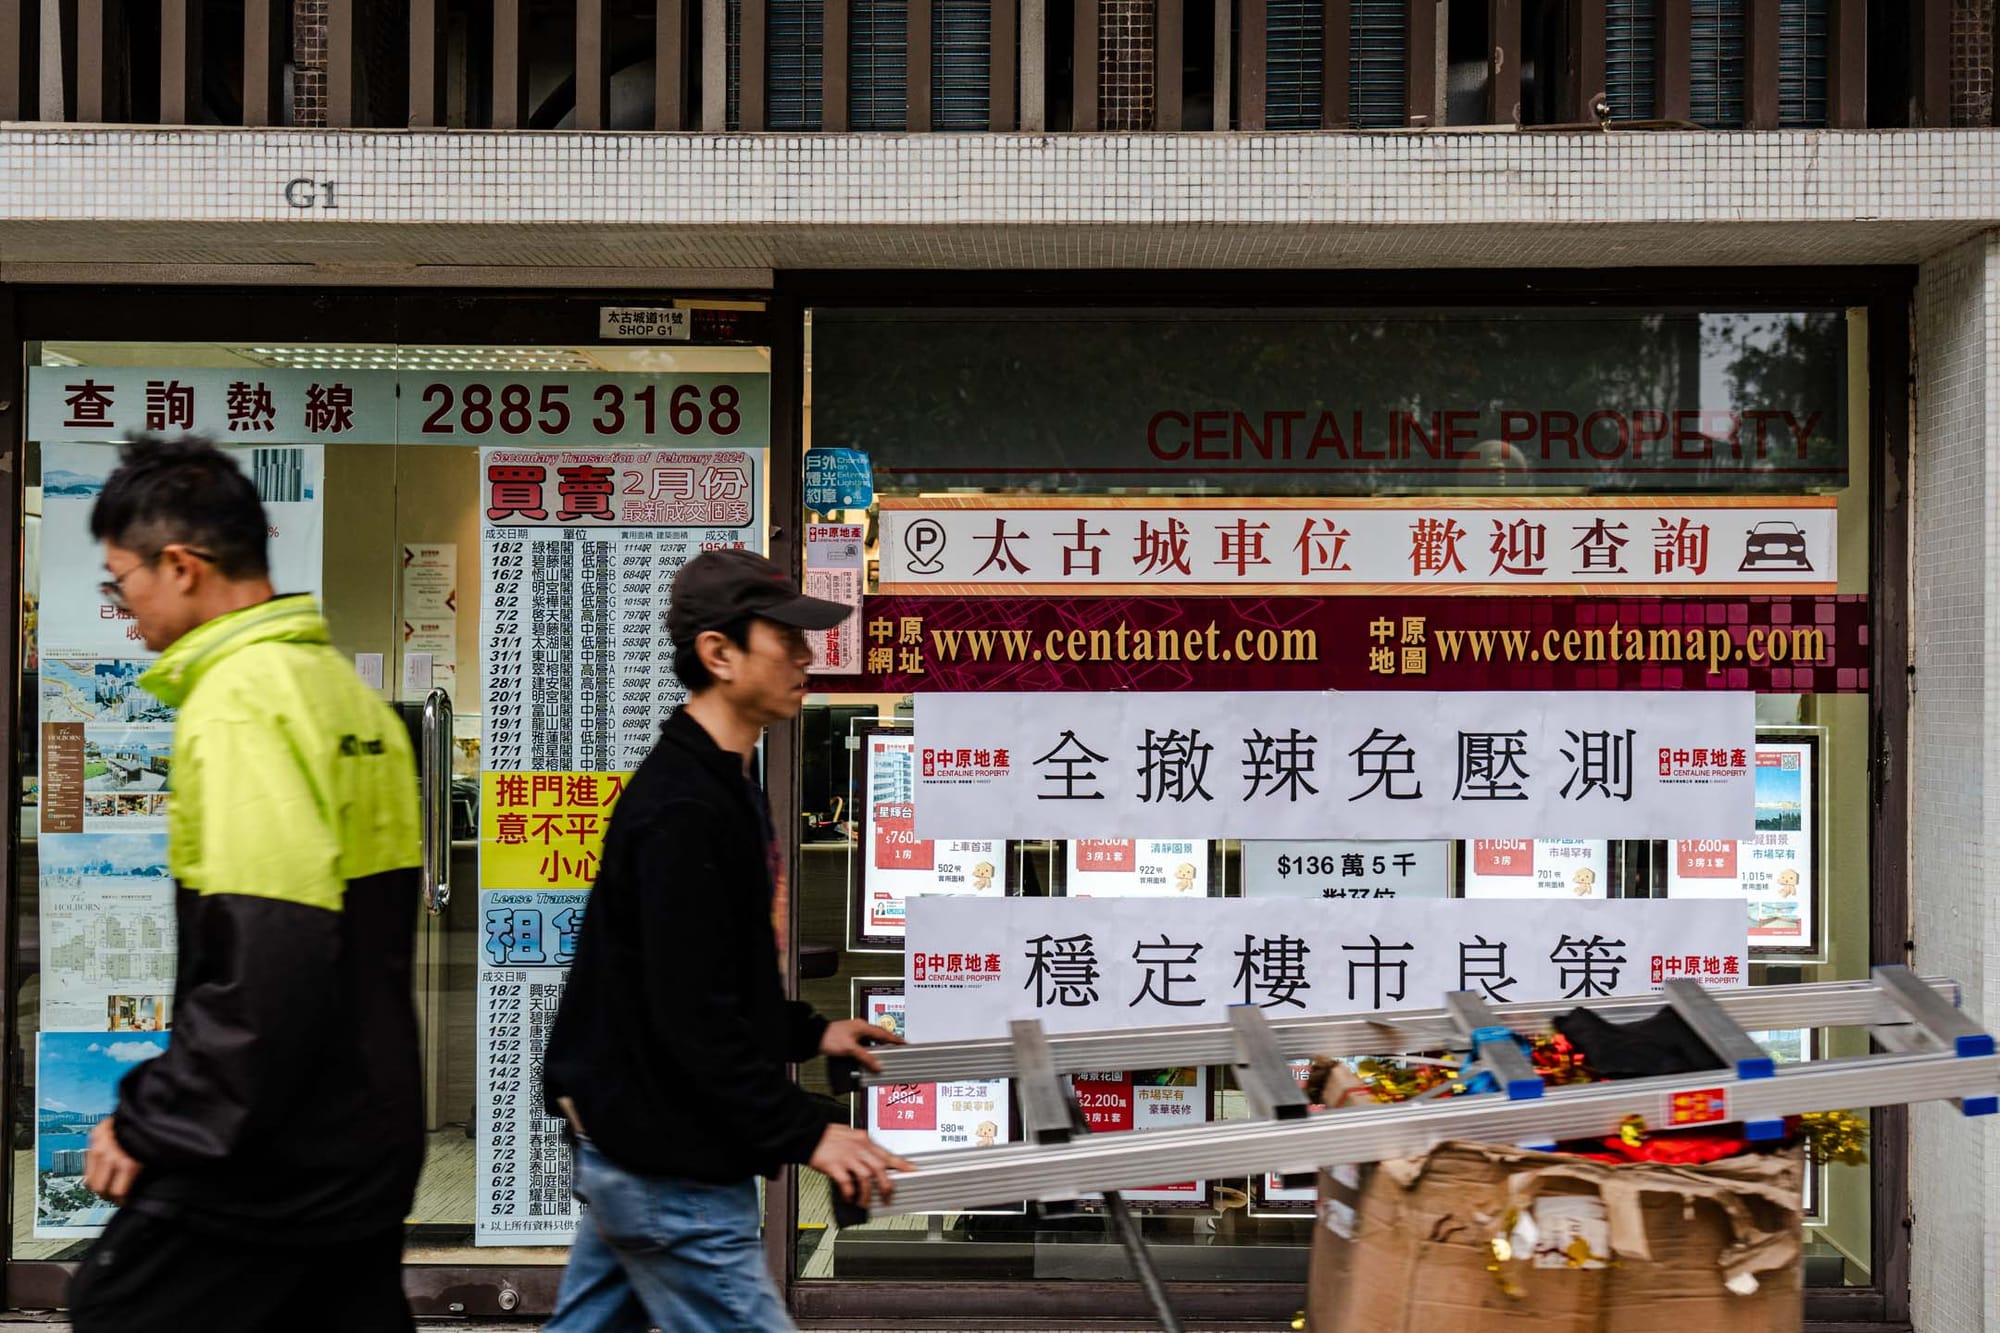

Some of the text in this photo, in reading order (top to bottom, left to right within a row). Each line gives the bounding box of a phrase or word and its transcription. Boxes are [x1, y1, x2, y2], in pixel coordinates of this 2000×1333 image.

[285, 177, 339, 210] G1
[607, 312, 684, 325] 太古城道11號
[618, 324, 673, 336] SHOP G1
[63, 378, 743, 437] 查詢熱線 2885 3168
[1146, 409, 1825, 462] CENTALINE PROPERTY
[492, 451, 745, 466] Secondary Transaction of February 2024
[621, 467, 749, 500] 2月份
[487, 465, 616, 522] 買賣
[621, 501, 749, 523] 最新成交個案
[485, 528, 529, 540] 成交日期
[563, 529, 588, 540] 單位
[705, 529, 739, 541] 成交價
[817, 527, 861, 538] 中原地產
[492, 542, 522, 553] 18/2
[971, 516, 1712, 578] 太古城車位 歡迎查詢
[492, 556, 522, 567] 18/2
[492, 569, 523, 580] 16/2
[494, 583, 518, 594] 8/2
[494, 596, 518, 607] 8/2
[495, 610, 518, 621] 7/2
[494, 623, 518, 634] 5/2
[868, 616, 925, 645] 中原
[1369, 616, 1427, 645] 中原
[490, 637, 522, 648] 31/1
[931, 624, 1318, 663] www.centanet.com
[1434, 620, 1828, 675] www.centamap.com
[490, 650, 522, 661] 31/1
[867, 646, 925, 674] 網址
[1369, 646, 1427, 675] 地圖
[490, 664, 522, 675] 31/1
[489, 677, 522, 688] 28/1
[489, 691, 522, 702] 20/1
[490, 704, 522, 715] 19/1
[490, 718, 522, 729] 19/1
[490, 731, 522, 742] 19/1
[490, 745, 522, 756] 17/1
[490, 758, 522, 769] 17/1
[936, 748, 1010, 768] 中原地產
[1672, 748, 1747, 768] 中原地產
[1032, 726, 1638, 804] 全撤辣免壓測
[936, 769, 1010, 777] CENTALINE PROPERTY
[1673, 769, 1747, 777] CENTALINE PROPERTY
[495, 774, 625, 808] 推門進入
[495, 812, 612, 846] 意不平
[1277, 852, 1417, 878] $136 萬 5 千
[491, 893, 533, 905] Lease
[927, 953, 1001, 973] 中原地產
[1665, 955, 1740, 976] 中原地產
[1023, 932, 1628, 1010] 穩定樓市良策
[482, 971, 527, 983] 成交日期
[928, 974, 1001, 982] CENTALINE PROPERTY
[1704, 976, 1740, 985] PROPERTY
[489, 985, 521, 996] 18/2
[489, 999, 521, 1010] 17/2
[489, 1012, 521, 1023] 17/2
[489, 1026, 521, 1037] 15/2
[489, 1040, 521, 1051] 15/2
[489, 1053, 521, 1064] 14/2
[489, 1067, 521, 1078] 14/2
[489, 1081, 521, 1092] 14/2
[492, 1094, 515, 1105] 9/2
[1138, 1089, 1185, 1101] 市場罕有
[492, 1108, 515, 1119] 9/2
[1148, 1103, 1193, 1116] 豪華裝修
[492, 1122, 515, 1133] 8/2
[492, 1135, 515, 1146] 8/2
[492, 1149, 515, 1160] 7/2
[492, 1163, 515, 1174] 6/2
[492, 1177, 515, 1188] 6/2
[492, 1190, 515, 1201] 6/2
[492, 1204, 515, 1215] 5/2
